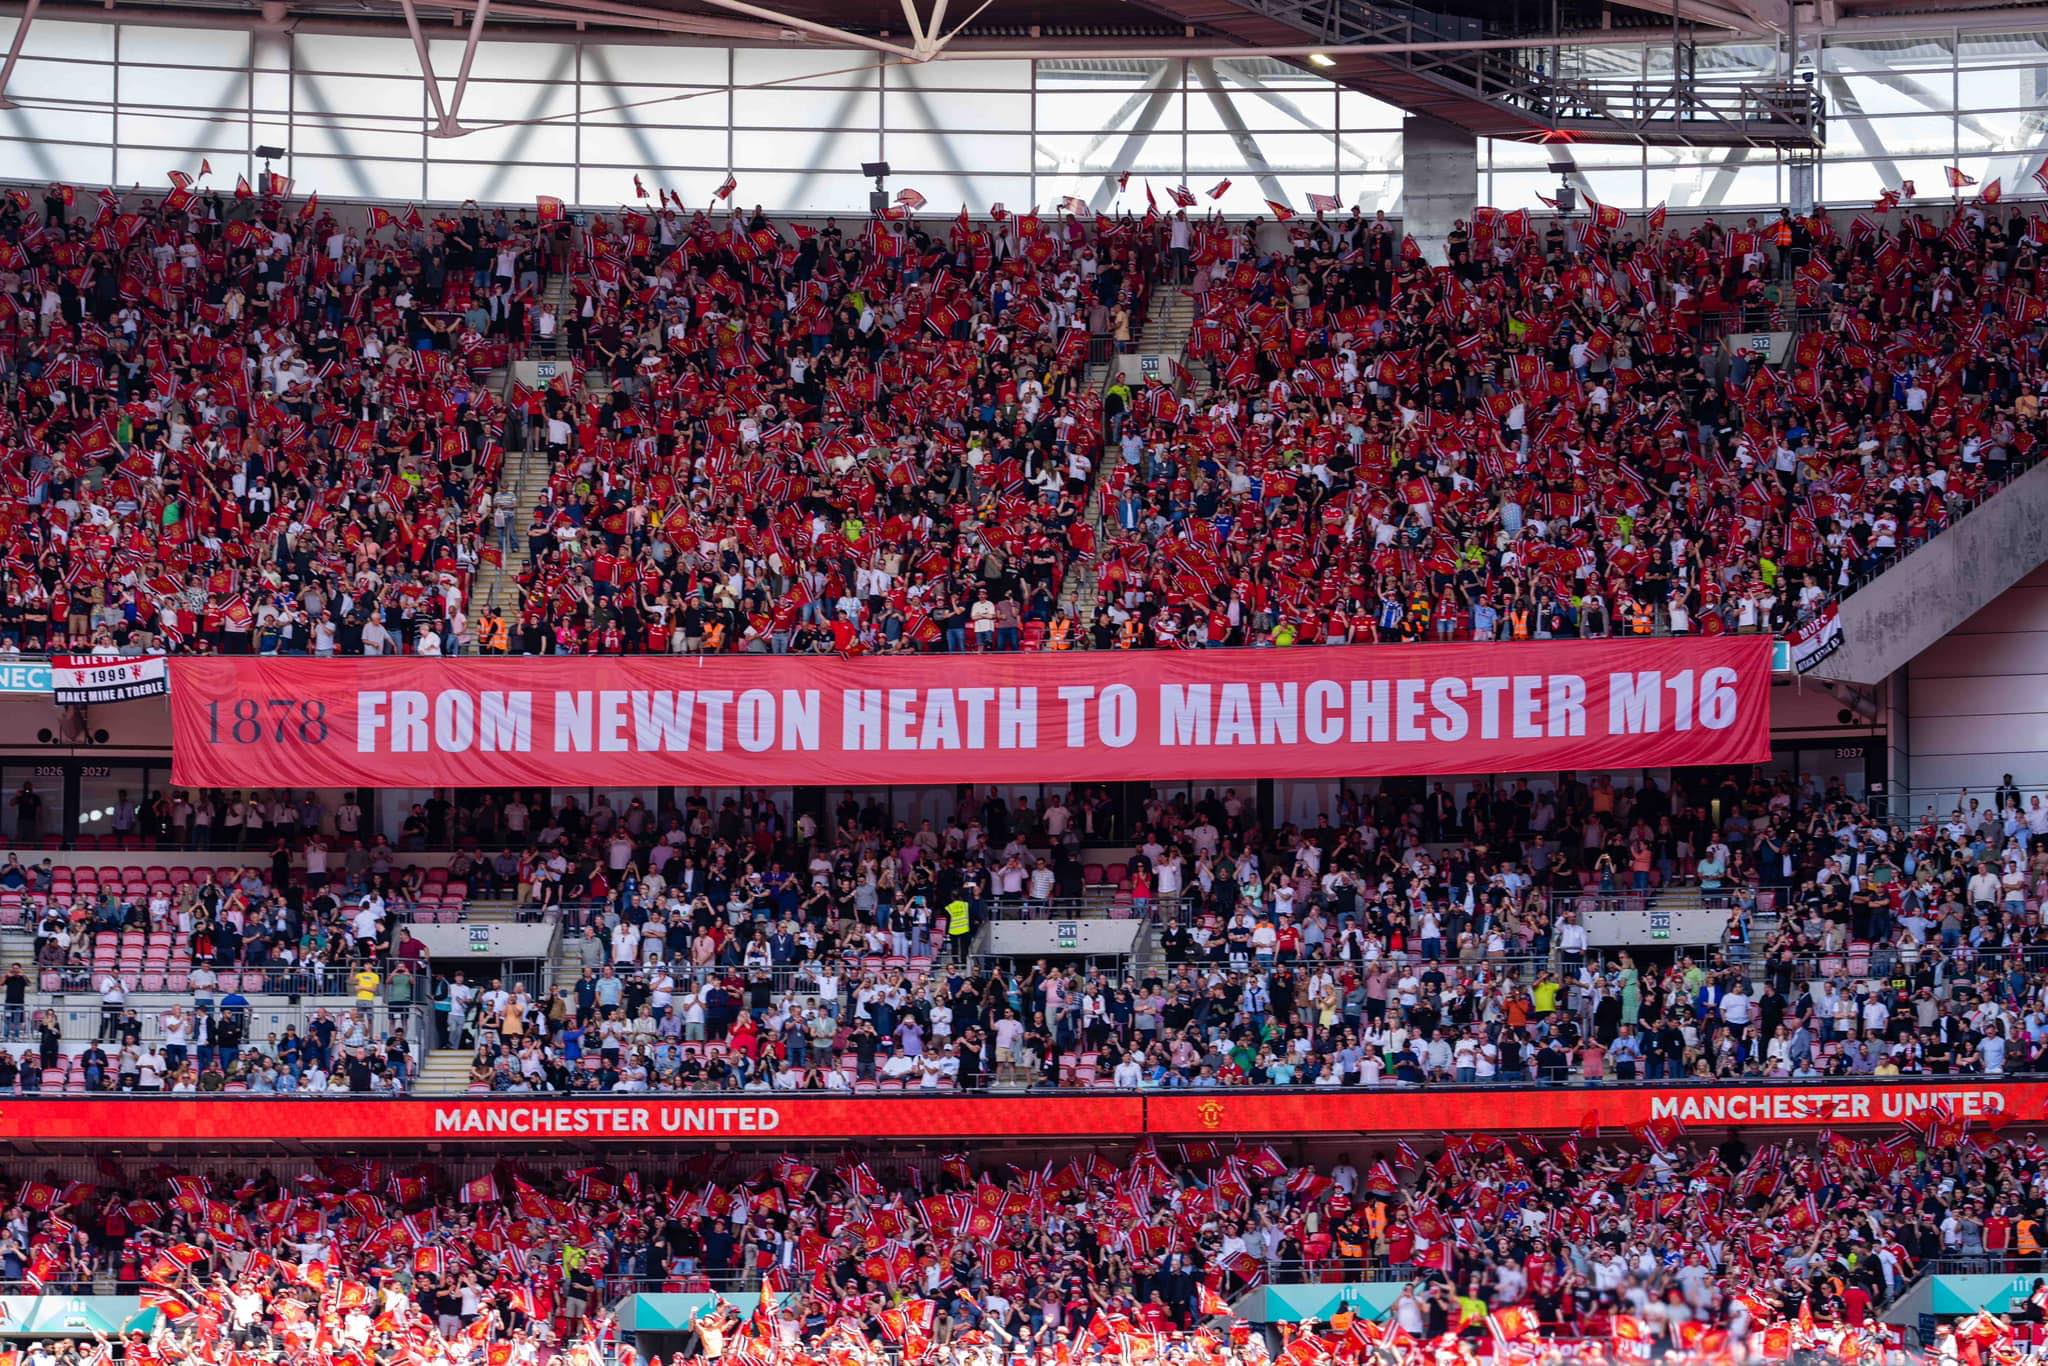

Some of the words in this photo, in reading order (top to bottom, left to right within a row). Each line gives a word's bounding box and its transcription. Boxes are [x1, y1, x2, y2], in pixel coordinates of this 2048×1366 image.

[1752, 339, 1769, 348] 512
[1142, 360, 1158, 369] 511
[538, 367, 555, 376] 510
[1798, 614, 1829, 640] MUFC
[91, 668, 126, 683] 1999
[57, 691, 87, 702] MAKE
[88, 689, 116, 702] MINE
[117, 688, 125, 699] A
[125, 681, 164, 698] TREBLE
[204, 698, 329, 745] 1878
[357, 689, 532, 753] FROM
[554, 688, 820, 752] NEWTON
[842, 686, 1038, 750] HEATH
[1058, 683, 1138, 748] TO
[1159, 674, 1587, 746] MANCHESTER
[1608, 666, 1738, 735] M16
[1836, 748, 1864, 758] 3037
[36, 766, 64, 776] 3026
[81, 766, 109, 776] 3027
[1652, 918, 1669, 927] 212
[470, 930, 488, 939] 210
[1060, 927, 1076, 936] 211
[1651, 1093, 1870, 1120] MANCHESTER
[1882, 1091, 2005, 1118] UNITED
[434, 1108, 649, 1132] MANCHESTER
[661, 1107, 780, 1131] UNITED
